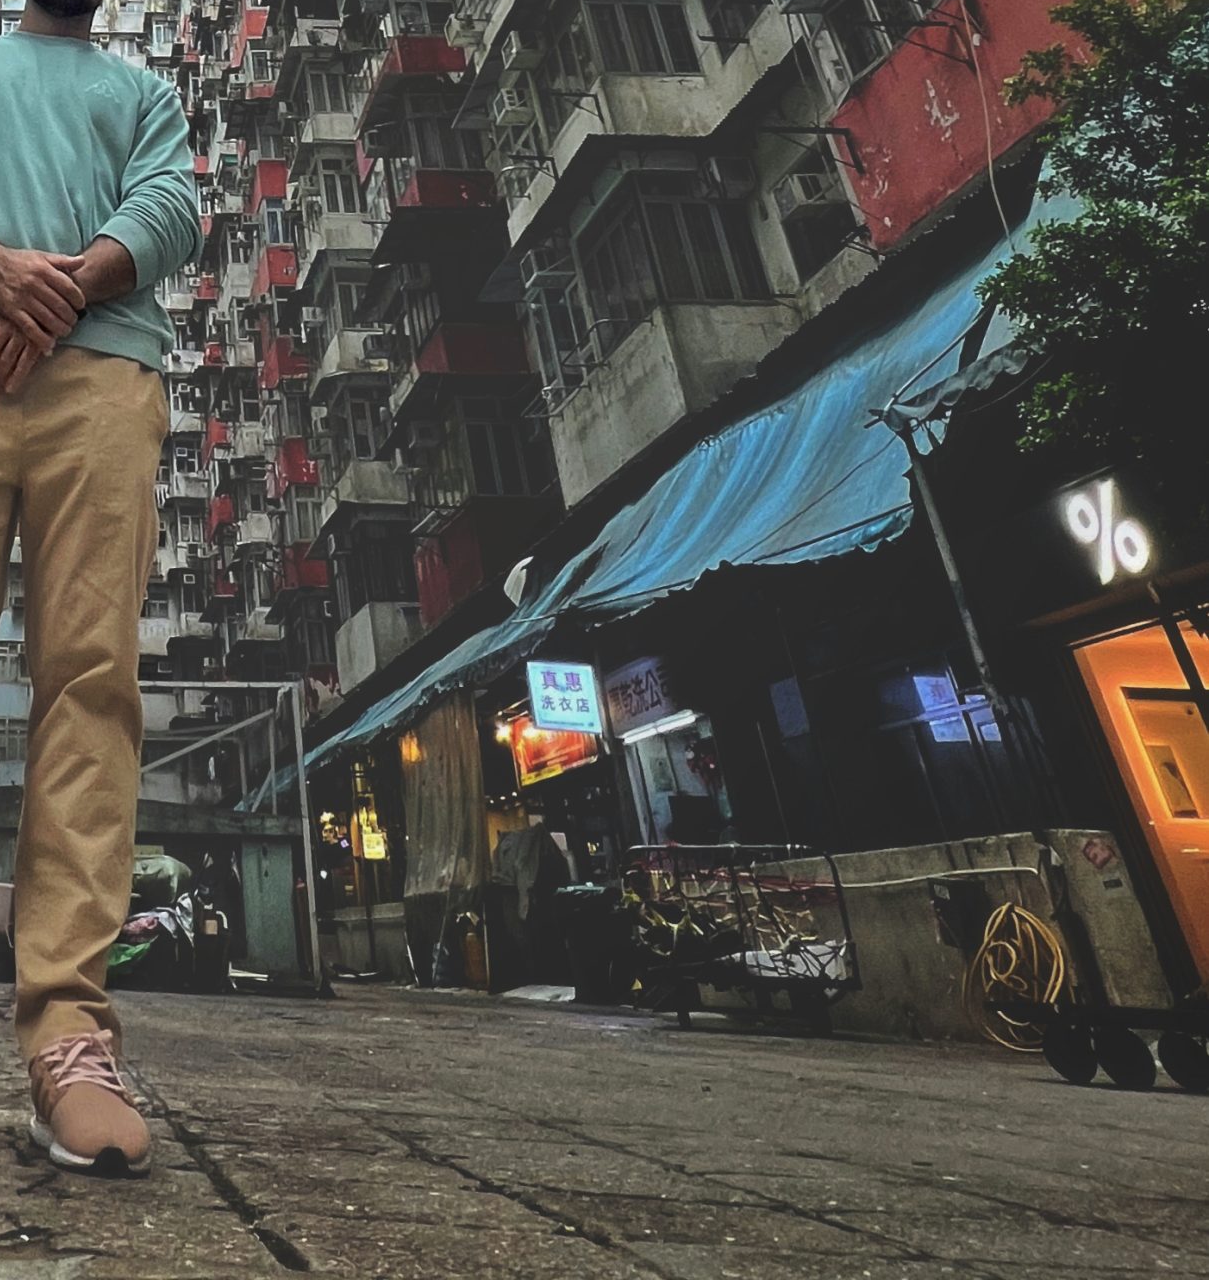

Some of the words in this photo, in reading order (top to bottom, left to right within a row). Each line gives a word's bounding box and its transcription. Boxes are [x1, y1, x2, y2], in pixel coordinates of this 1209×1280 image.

[541, 671, 583, 692] 真惠
[541, 696, 590, 713] 洗衣店
